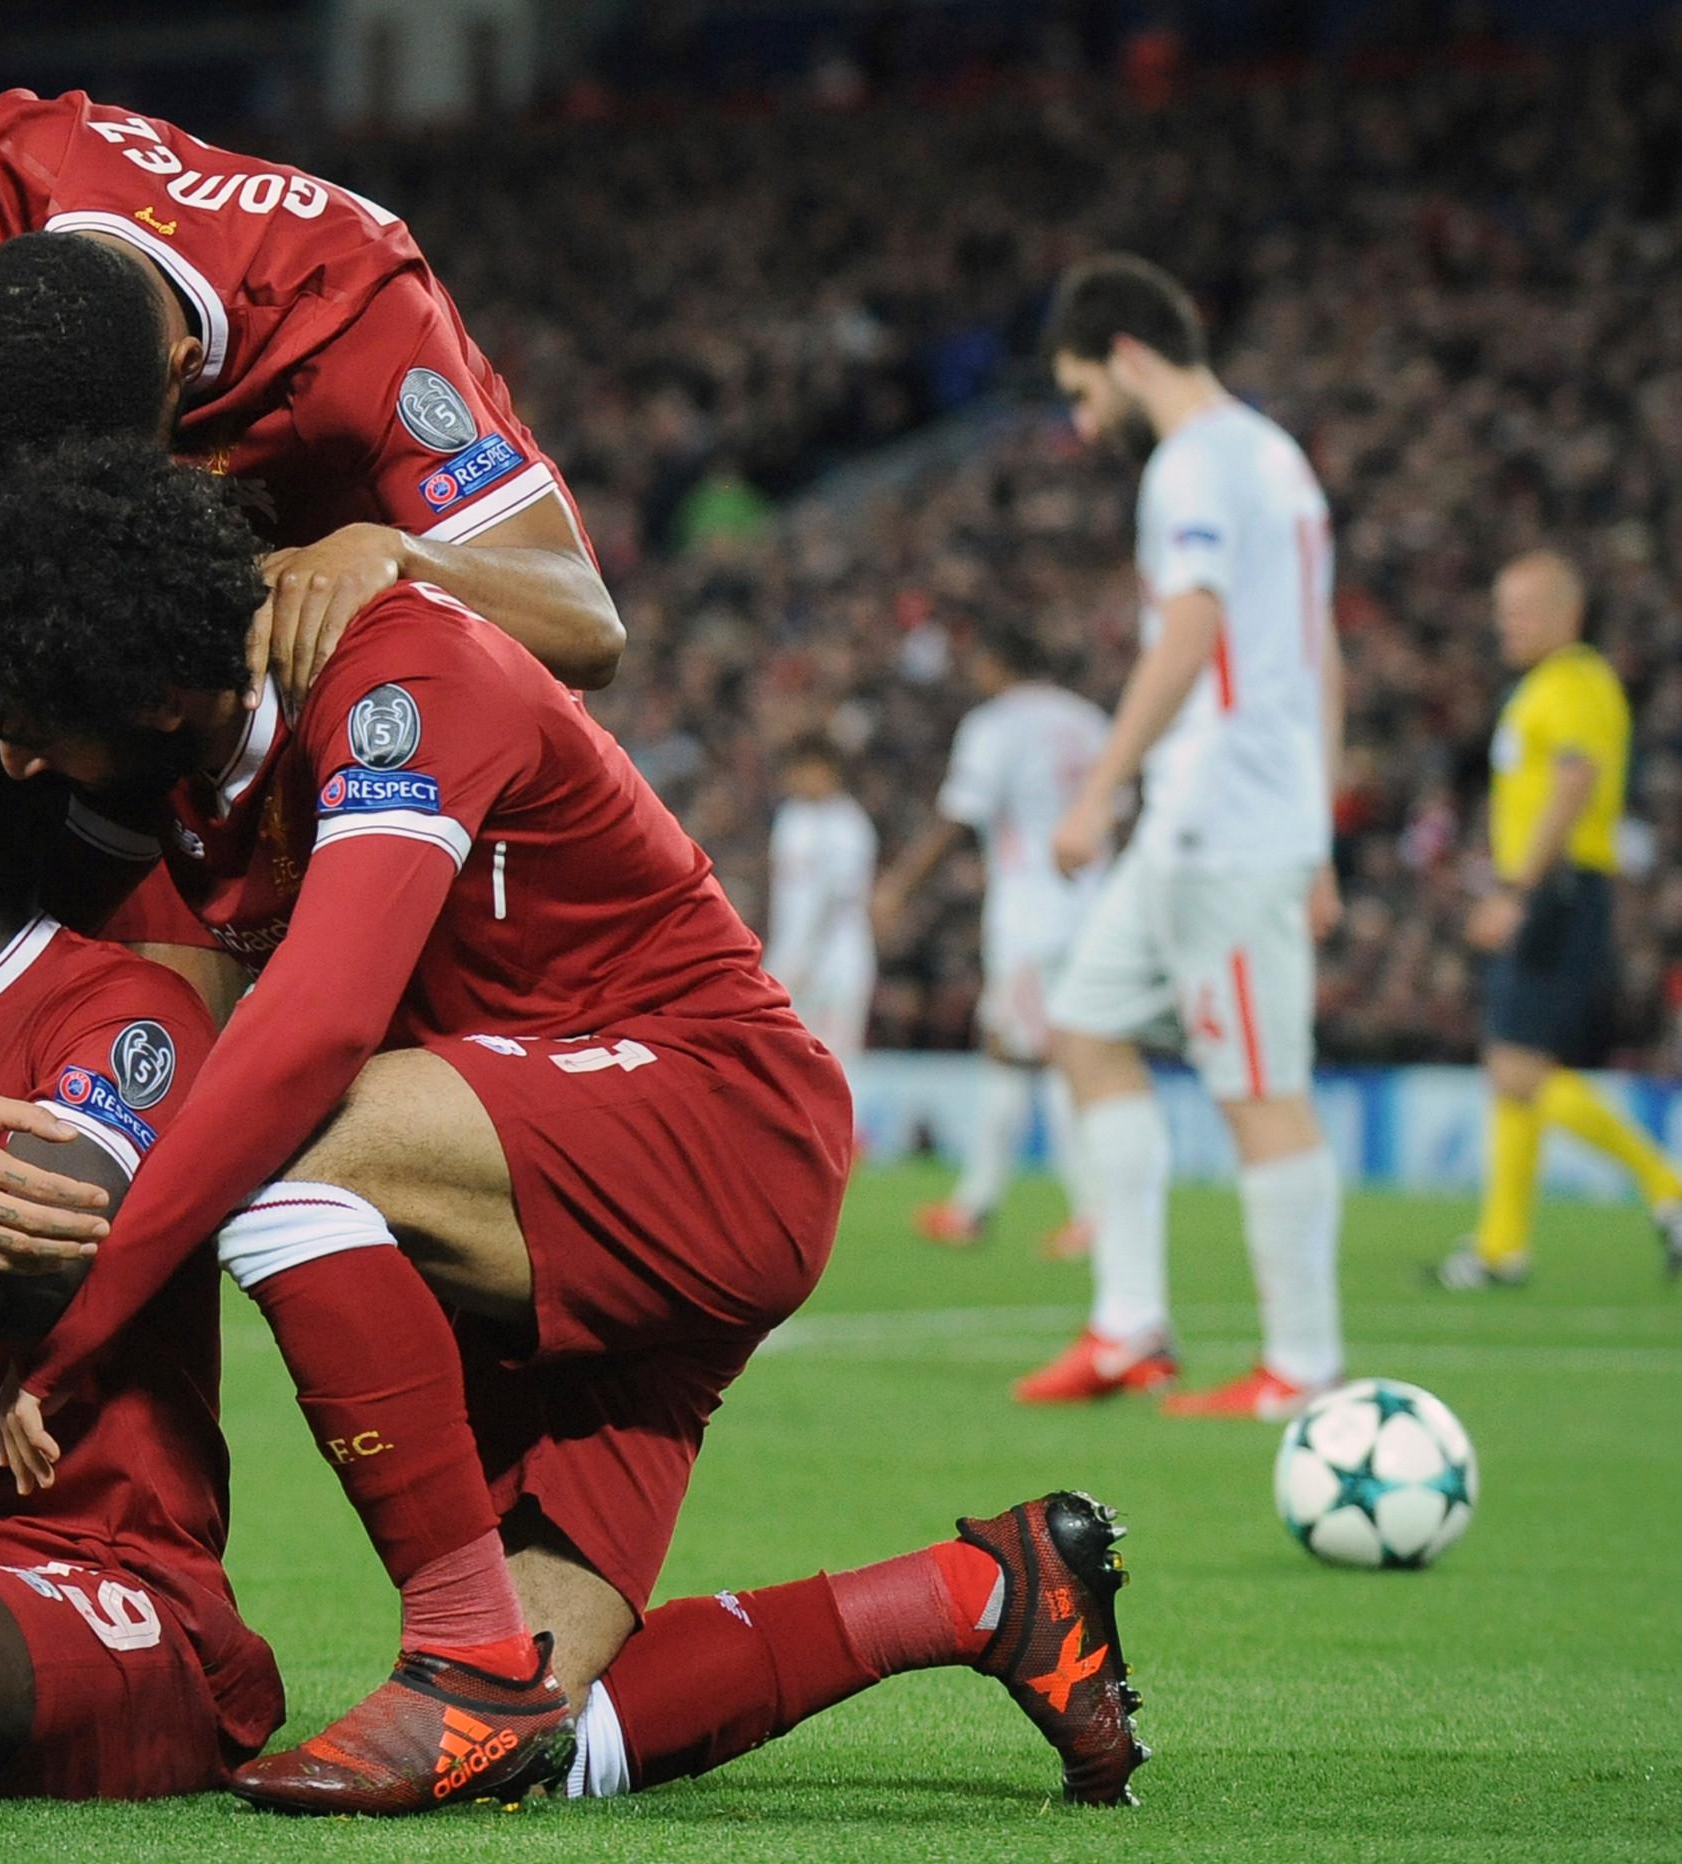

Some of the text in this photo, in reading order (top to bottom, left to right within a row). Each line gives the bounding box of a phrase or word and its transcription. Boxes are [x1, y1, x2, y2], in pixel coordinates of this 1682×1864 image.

[87, 117, 330, 219] GOMEZ
[434, 404, 457, 428] 5
[454, 440, 516, 486] RESPECT
[373, 723, 392, 745] 5
[347, 780, 439, 801] RESPECT
[134, 1060, 152, 1083] 5
[90, 1087, 156, 1147] RESPEC
[433, 1728, 518, 1799] adidas
